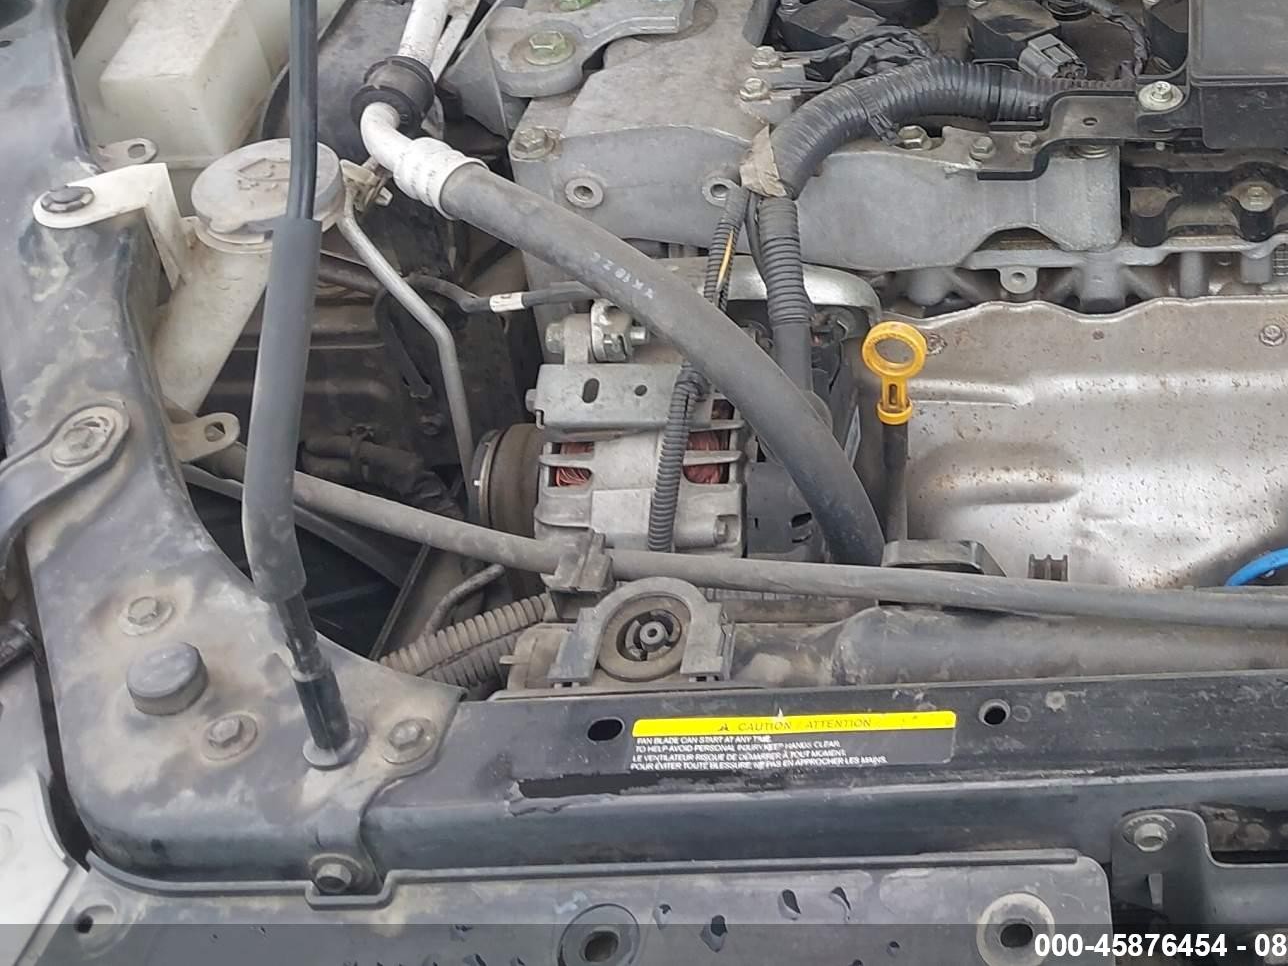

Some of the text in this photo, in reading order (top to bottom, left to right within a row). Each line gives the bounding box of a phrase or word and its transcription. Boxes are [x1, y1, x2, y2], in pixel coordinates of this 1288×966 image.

[738, 721, 793, 731] CAUTION
[806, 718, 872, 729] ATTENTION
[654, 736, 679, 744] BLADE
[681, 736, 698, 744] CAN
[699, 736, 723, 744] START
[735, 735, 752, 743] ANY
[636, 745, 646, 753] TO
[694, 744, 736, 752] PERSONAL
[632, 755, 643, 763] LE
[643, 754, 695, 763] VENTILATEUR
[695, 753, 725, 762] RISQUE
[790, 750, 811, 759] TOUT
[630, 763, 655, 772] POUR
[683, 762, 709, 771] TOUTE
[766, 760, 782, 769] PAS
[795, 757, 844, 767] APPROCHER
[845, 756, 860, 765] LES
